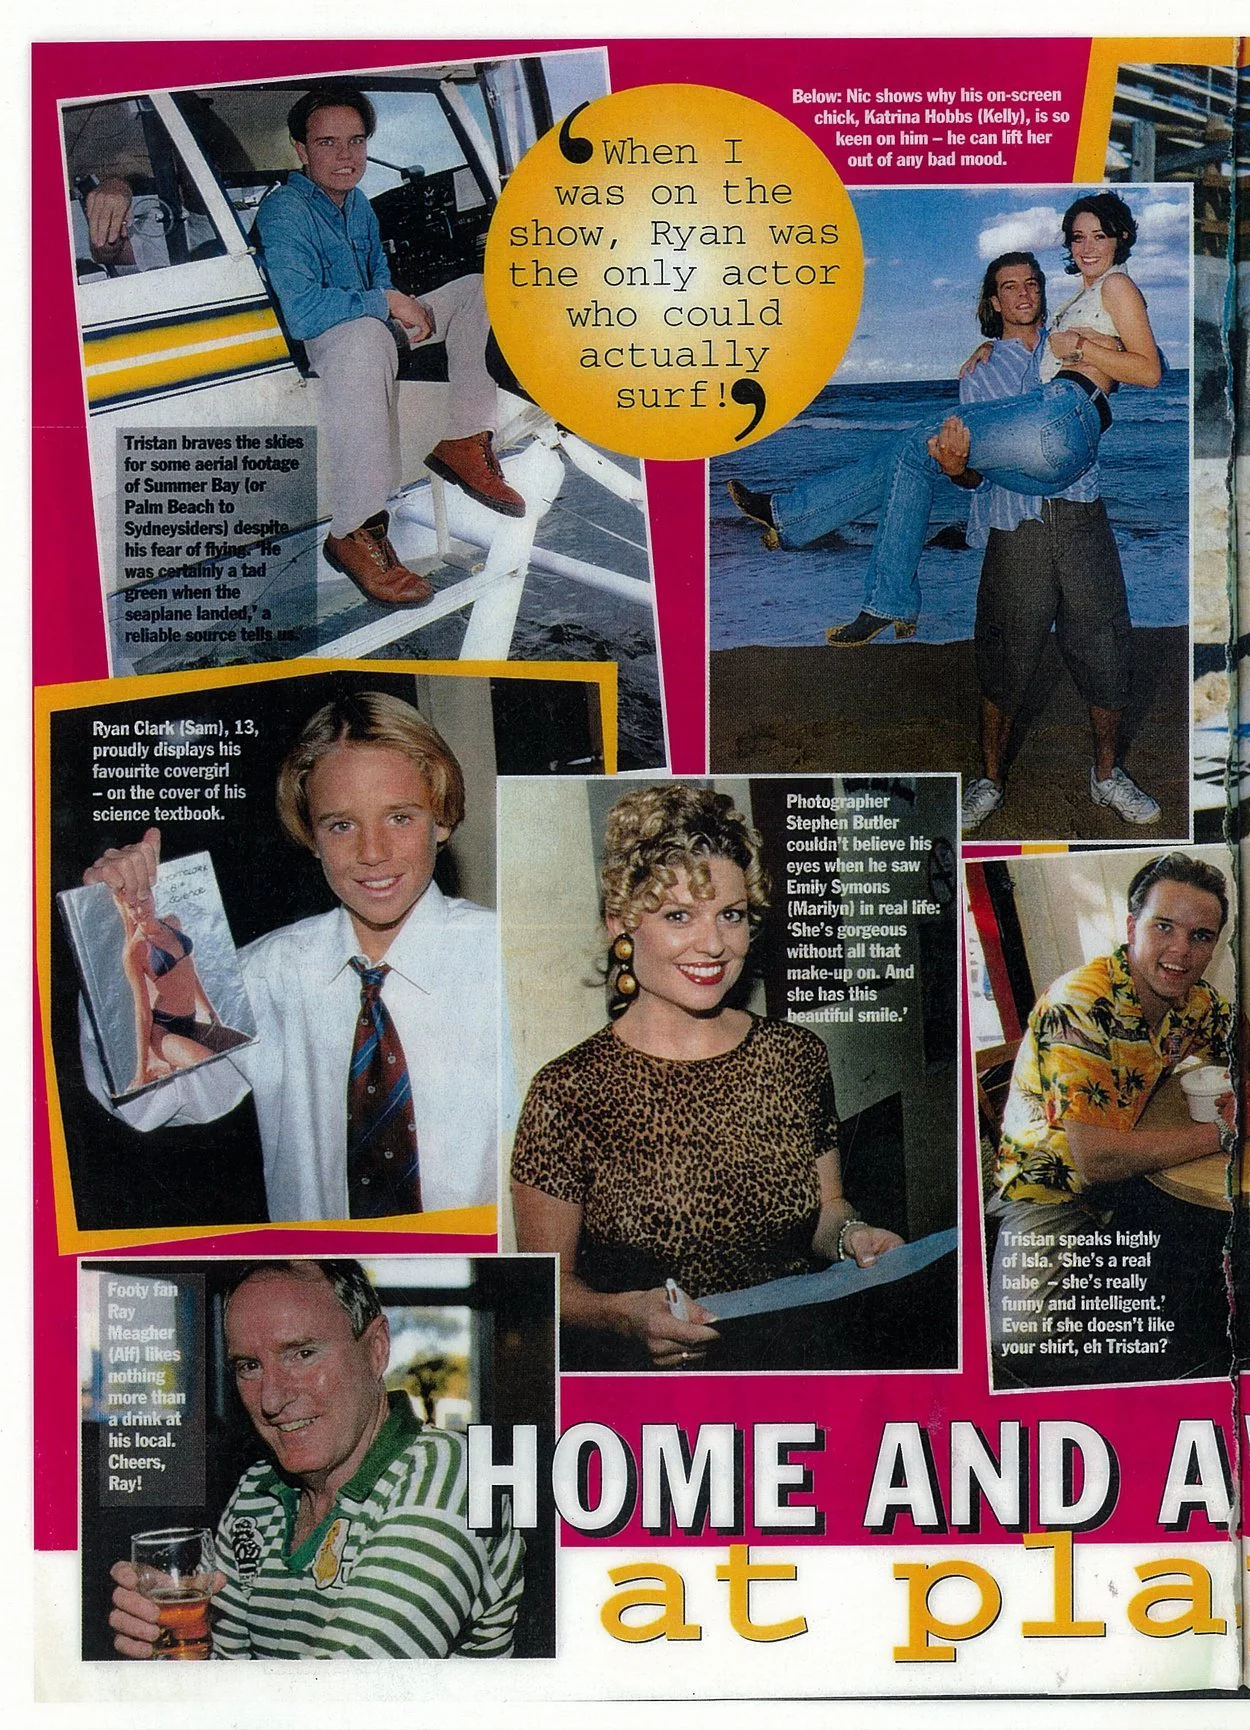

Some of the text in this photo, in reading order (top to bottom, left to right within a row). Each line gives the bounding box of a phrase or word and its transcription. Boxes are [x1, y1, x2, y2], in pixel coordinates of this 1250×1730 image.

[793, 88, 1062, 104] Below: Nic shows why his on-screen
[814, 108, 1070, 127] chick, Katrina Hobbs (Kelly), is so
[836, 130, 1052, 146] keen on him he can lift her
[724, 139, 743, 164] I
[848, 151, 1007, 169] out of any bad mood.
[555, 177, 792, 206] was on the
[510, 219, 839, 251] show, Ryan was
[510, 259, 840, 292] the only actor
[566, 299, 783, 328] who could
[580, 340, 770, 373] actually
[124, 434, 304, 450] Tristan braves the skies
[124, 456, 299, 472] for some aerial footage
[125, 477, 266, 494] of Summer Bay (or
[125, 499, 234, 514] Palm Beach to
[93, 720, 259, 738] Ryan Clark (Sam), 13,
[93, 741, 241, 760] proudly displays his
[92, 763, 229, 780] favourite covergirl
[107, 784, 246, 799] on the cover of his
[787, 794, 890, 811] Photographer
[93, 806, 225, 821] science textbook.
[786, 815, 900, 832] Stephen Butler
[853, 836, 905, 851] believe
[910, 836, 932, 850] his
[787, 858, 920, 875] eyes when he saw
[787, 879, 890, 897] Emily Symons
[1002, 1231, 1161, 1249] Tristan speaks highly
[1001, 1339, 1167, 1356] your shirt, eh Tristan?
[109, 1433, 176, 1448] his local.
[109, 1455, 166, 1472] Cheers,
[109, 1476, 142, 1493] Ray!
[467, 1421, 826, 1538] HOME
[863, 1420, 1120, 1537] AND
[600, 1544, 808, 1644] at
